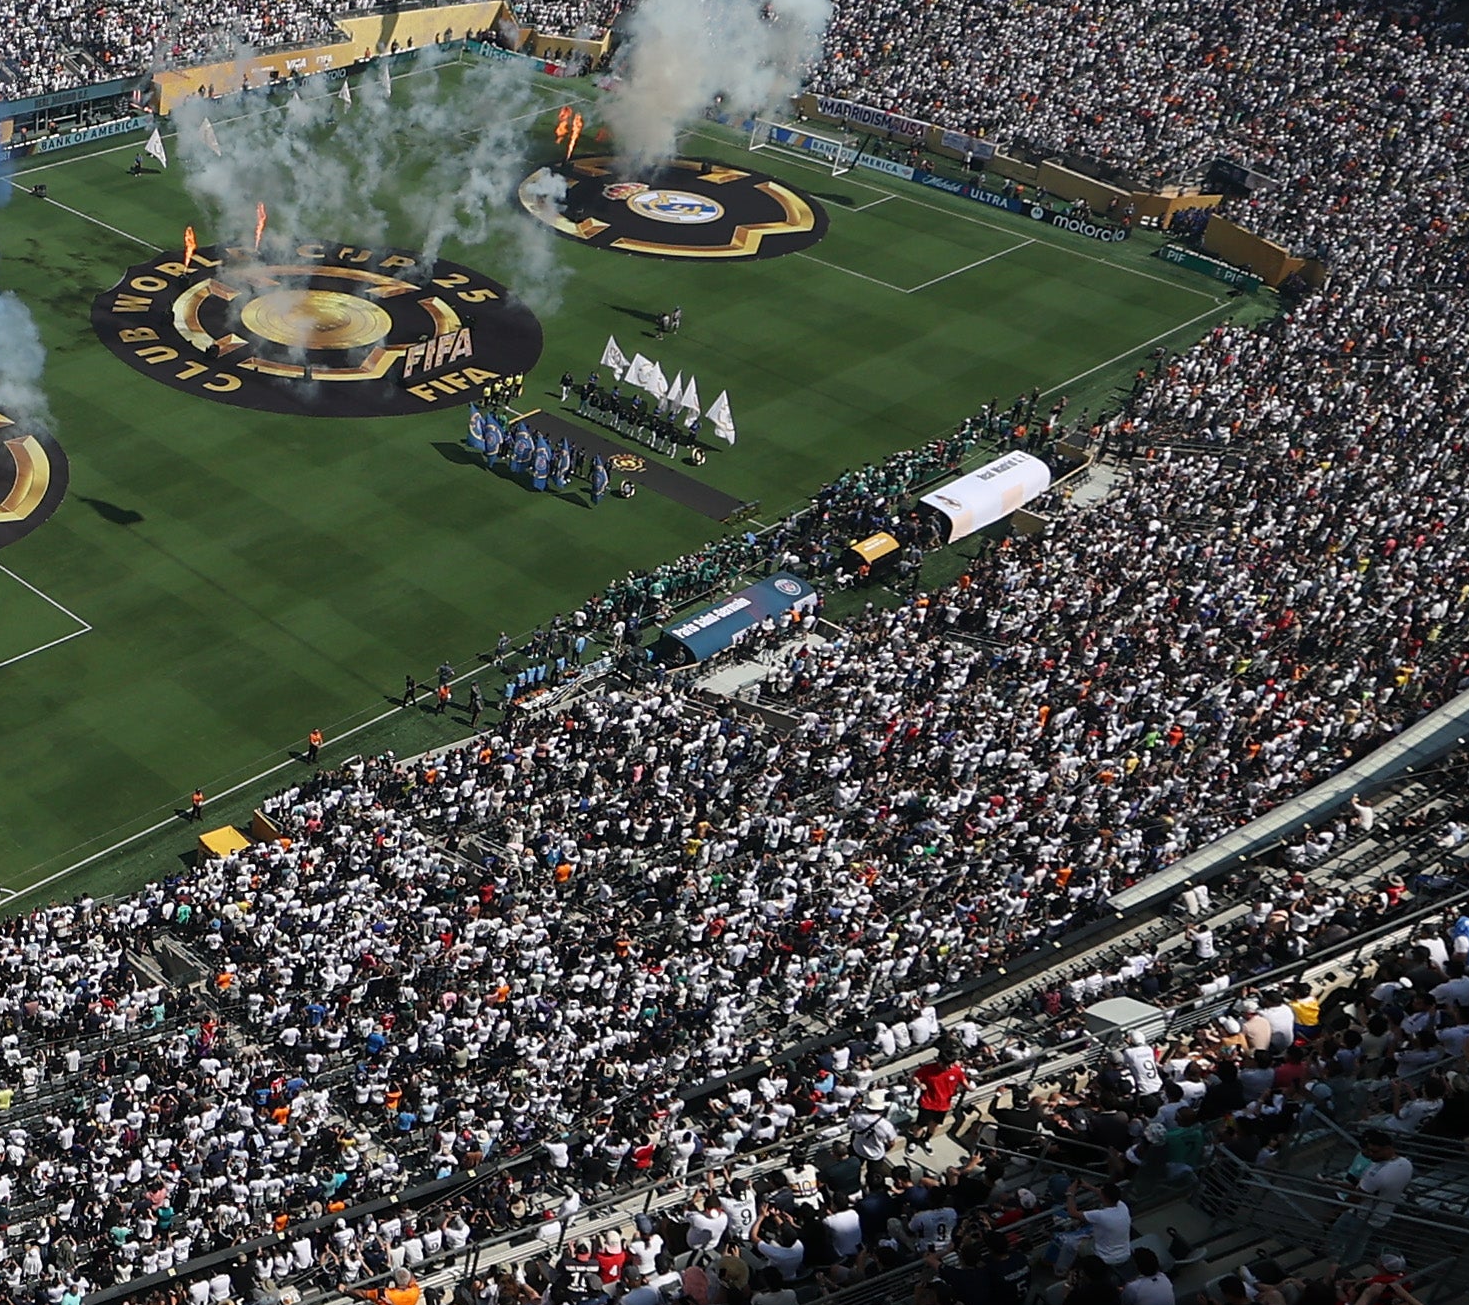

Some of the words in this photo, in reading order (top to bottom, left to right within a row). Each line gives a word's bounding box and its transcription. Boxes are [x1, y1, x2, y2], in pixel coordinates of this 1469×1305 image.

[41, 134, 71, 151] BANK
[74, 131, 90, 144] OF
[92, 119, 139, 139] AMERICA
[813, 141, 837, 157] BANK
[970, 188, 1008, 209] ULTRA
[1167, 250, 1186, 264] PIF
[118, 326, 244, 392] CLUB
[432, 273, 500, 303] 25
[402, 327, 474, 378] FIFA
[406, 365, 502, 403] FIFA
[672, 620, 700, 639] Paris
[700, 596, 752, 628] Saint-Germain
[1145, 1059, 1157, 1079] 9
[741, 1207, 751, 1226] 9
[936, 1222, 947, 1242] 9
